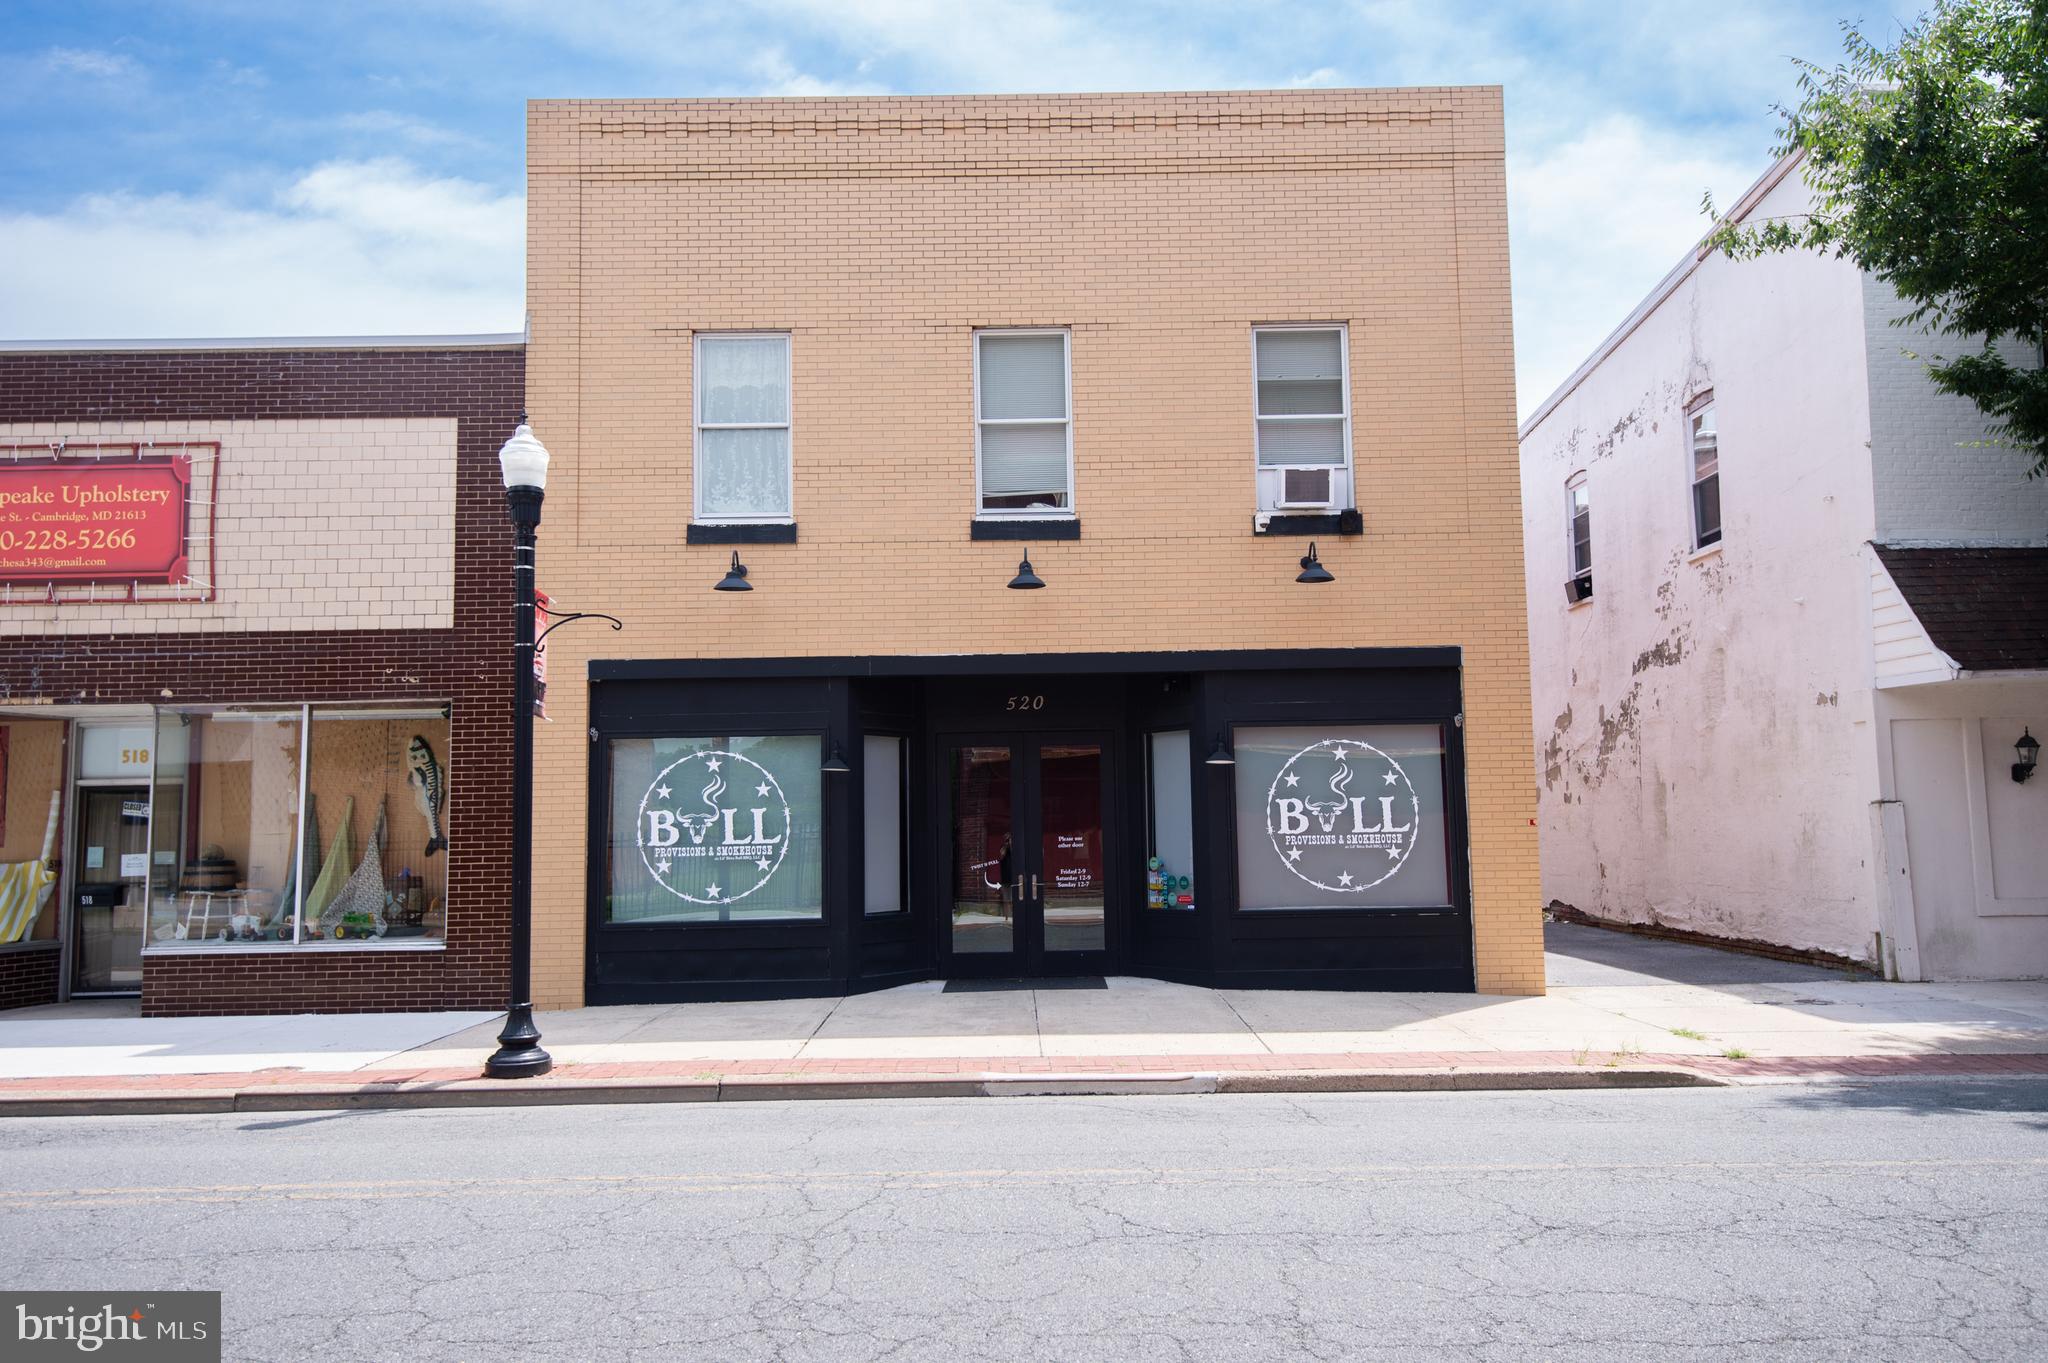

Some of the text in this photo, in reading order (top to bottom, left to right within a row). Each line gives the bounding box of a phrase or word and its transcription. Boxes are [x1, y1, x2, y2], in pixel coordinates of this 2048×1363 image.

[0, 484, 171, 508] peake Upholstery
[32, 511, 89, 523] Cambridge,
[92, 511, 112, 520] MD
[114, 510, 147, 520] 21613
[0, 528, 136, 550] 0-228-5266
[1006, 695, 1045, 710] 520
[122, 749, 149, 764] 518
[1285, 833, 1403, 846] PROVISIONS & SMOKEHOUSE
[655, 845, 773, 857] PROVISIONS & SMOKEHOUSE
[81, 895, 93, 905] 518
